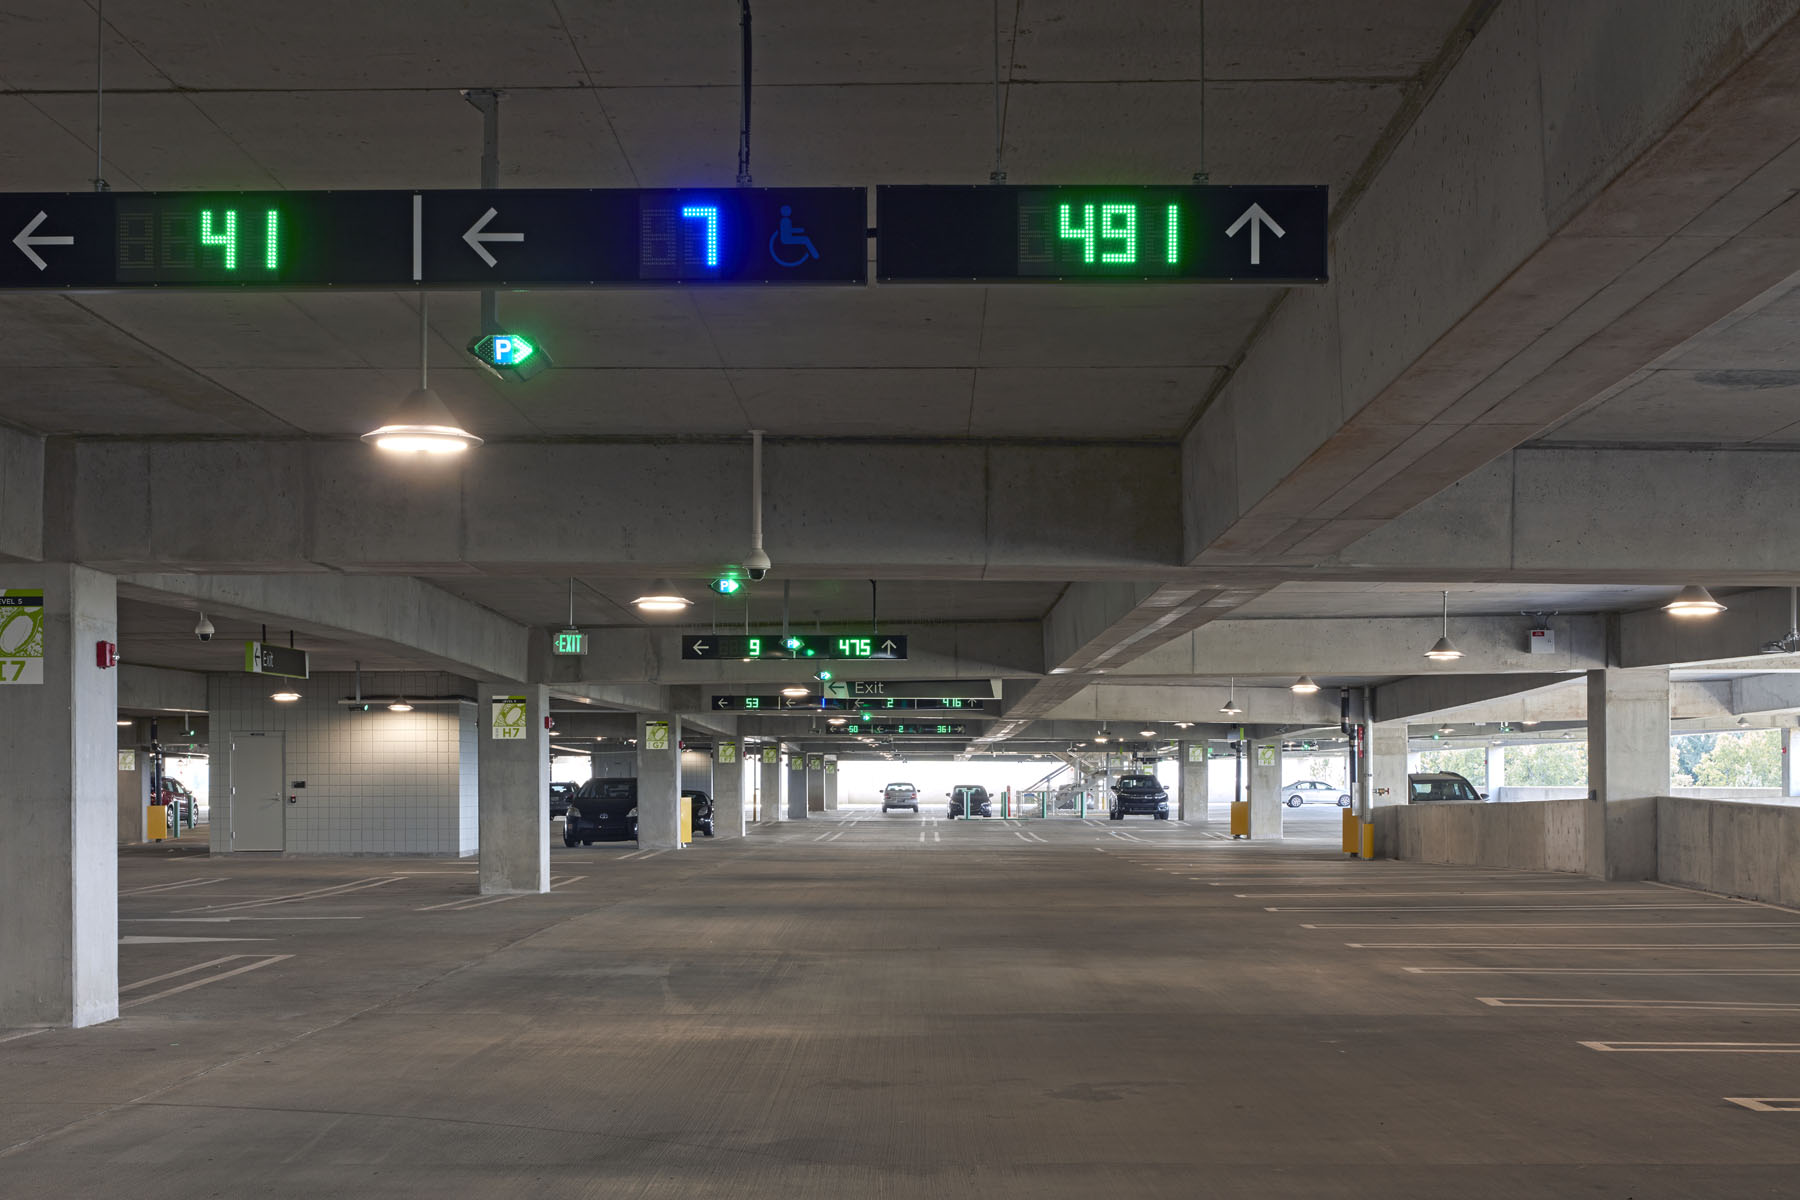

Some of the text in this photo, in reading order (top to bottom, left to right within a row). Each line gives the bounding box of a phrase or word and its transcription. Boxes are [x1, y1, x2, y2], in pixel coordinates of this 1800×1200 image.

[200, 203, 279, 270] 41
[680, 206, 719, 267] 7
[1058, 203, 1179, 265] 491
[494, 338, 512, 360] P
[559, 634, 582, 653] EXIT
[749, 639, 761, 656] 9
[839, 639, 871, 656] 475
[855, 681, 885, 694] Exit
[745, 698, 759, 709] 53
[886, 698, 894, 708] 2
[942, 698, 962, 708] 416
[502, 727, 520, 738] H7
[848, 725, 859, 734] 50
